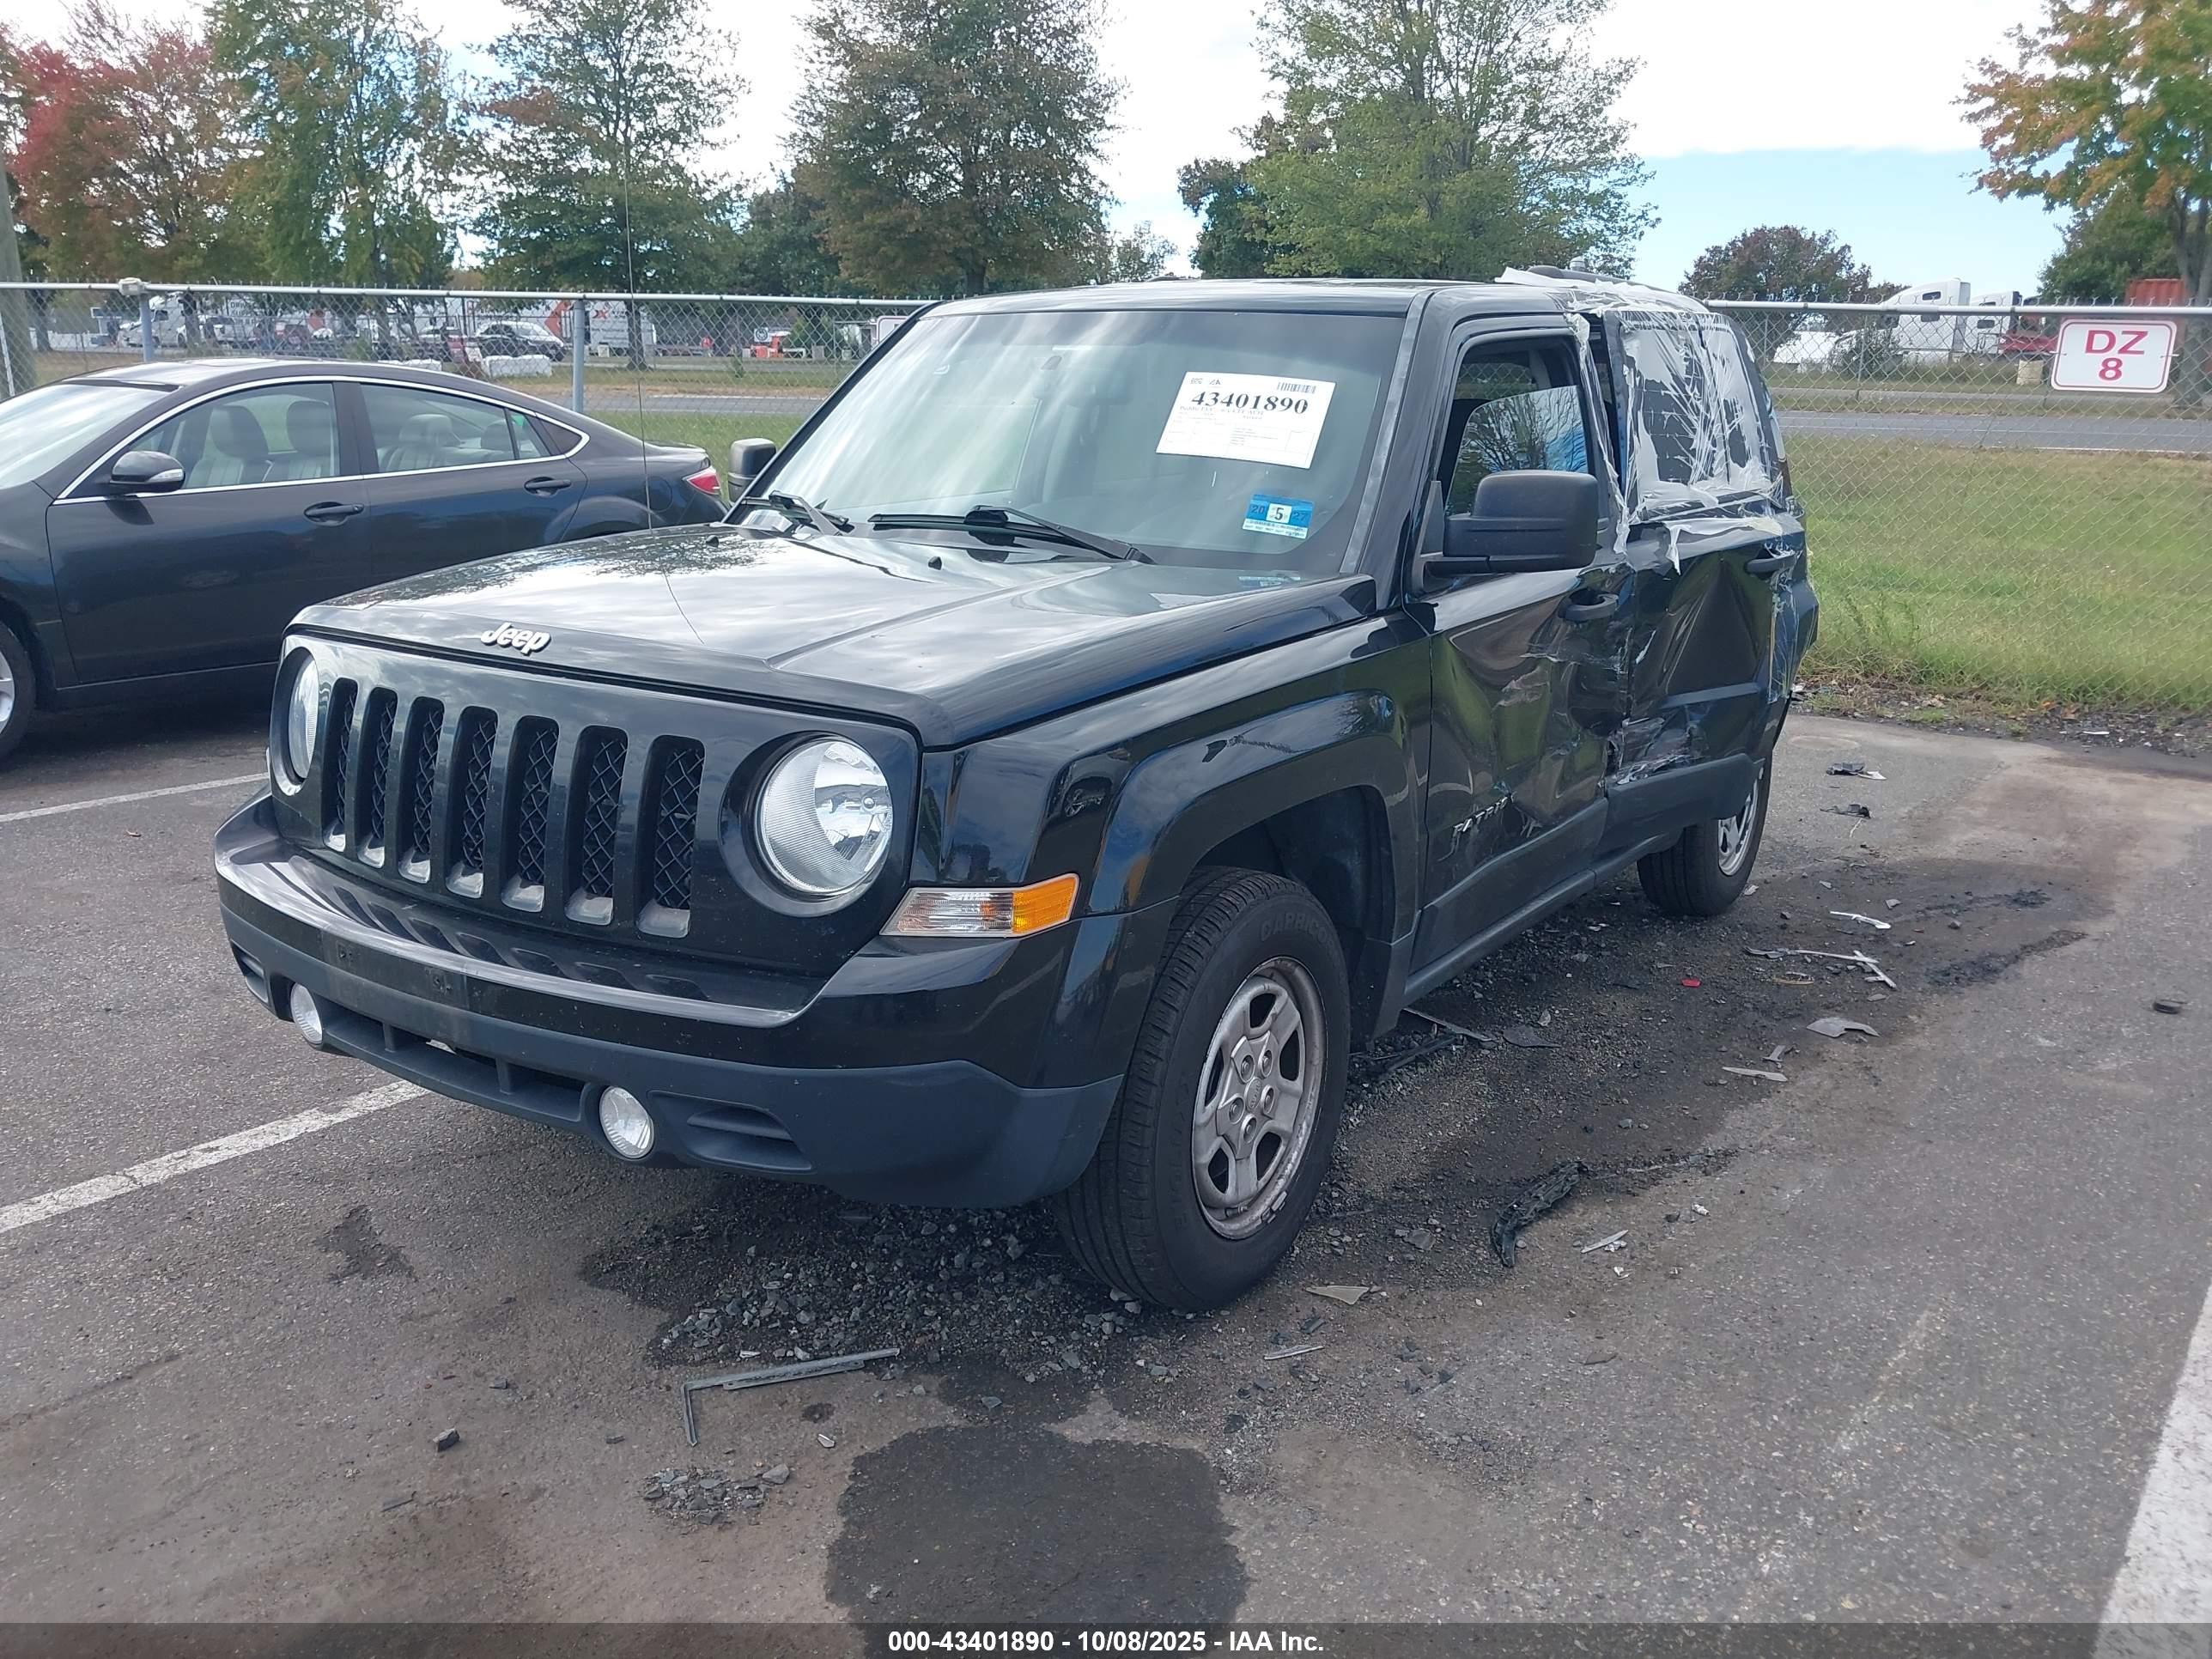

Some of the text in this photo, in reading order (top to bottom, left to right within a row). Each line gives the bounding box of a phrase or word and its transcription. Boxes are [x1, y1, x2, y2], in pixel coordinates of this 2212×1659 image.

[2084, 329, 2148, 356] DZ
[2098, 357, 2124, 381] 8
[1190, 391, 1310, 415] 43401890
[1250, 504, 1266, 515] 20
[1274, 507, 1285, 521] 5
[480, 621, 552, 657] Jeep
